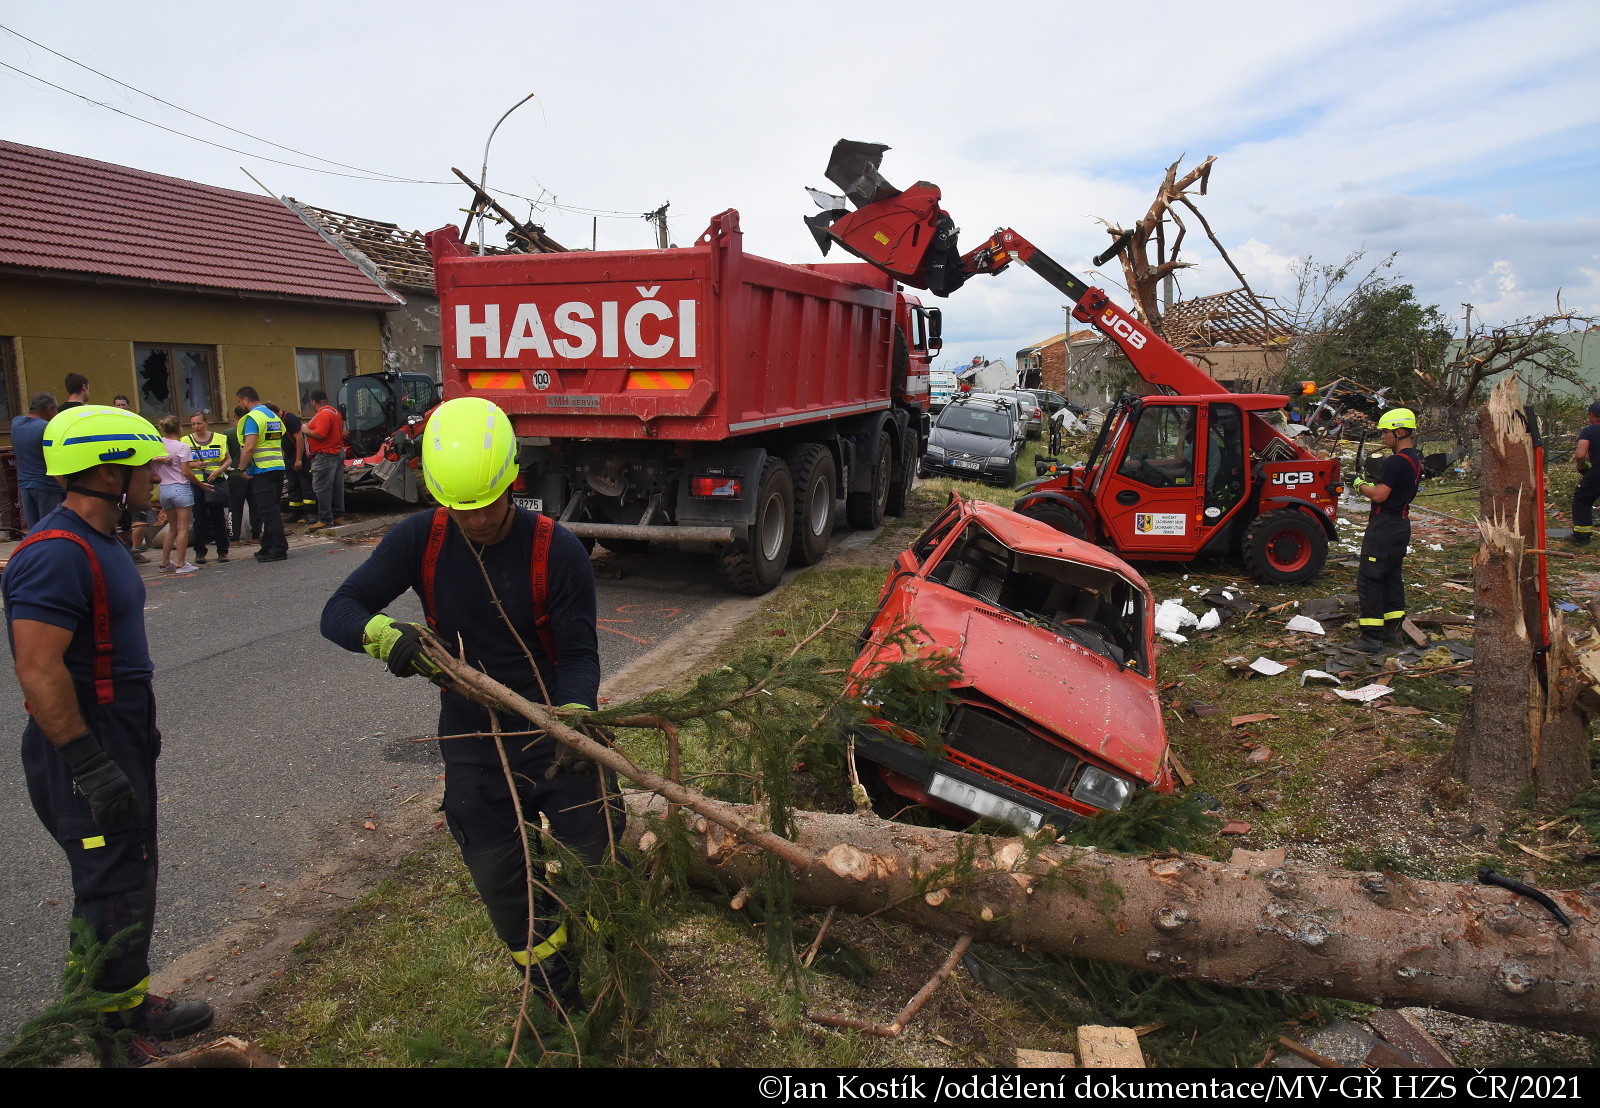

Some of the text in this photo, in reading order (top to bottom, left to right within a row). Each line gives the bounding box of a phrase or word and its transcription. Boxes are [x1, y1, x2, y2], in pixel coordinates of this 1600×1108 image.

[455, 285, 696, 359] HASIČI
[1101, 314, 1147, 350] JCB
[534, 373, 549, 385] 100
[547, 396, 569, 406] KMH
[1272, 471, 1314, 485] JCB
[519, 499, 539, 510] 8275
[426, 523, 445, 568] GoodPRO
[535, 521, 551, 563] GoodPRO
